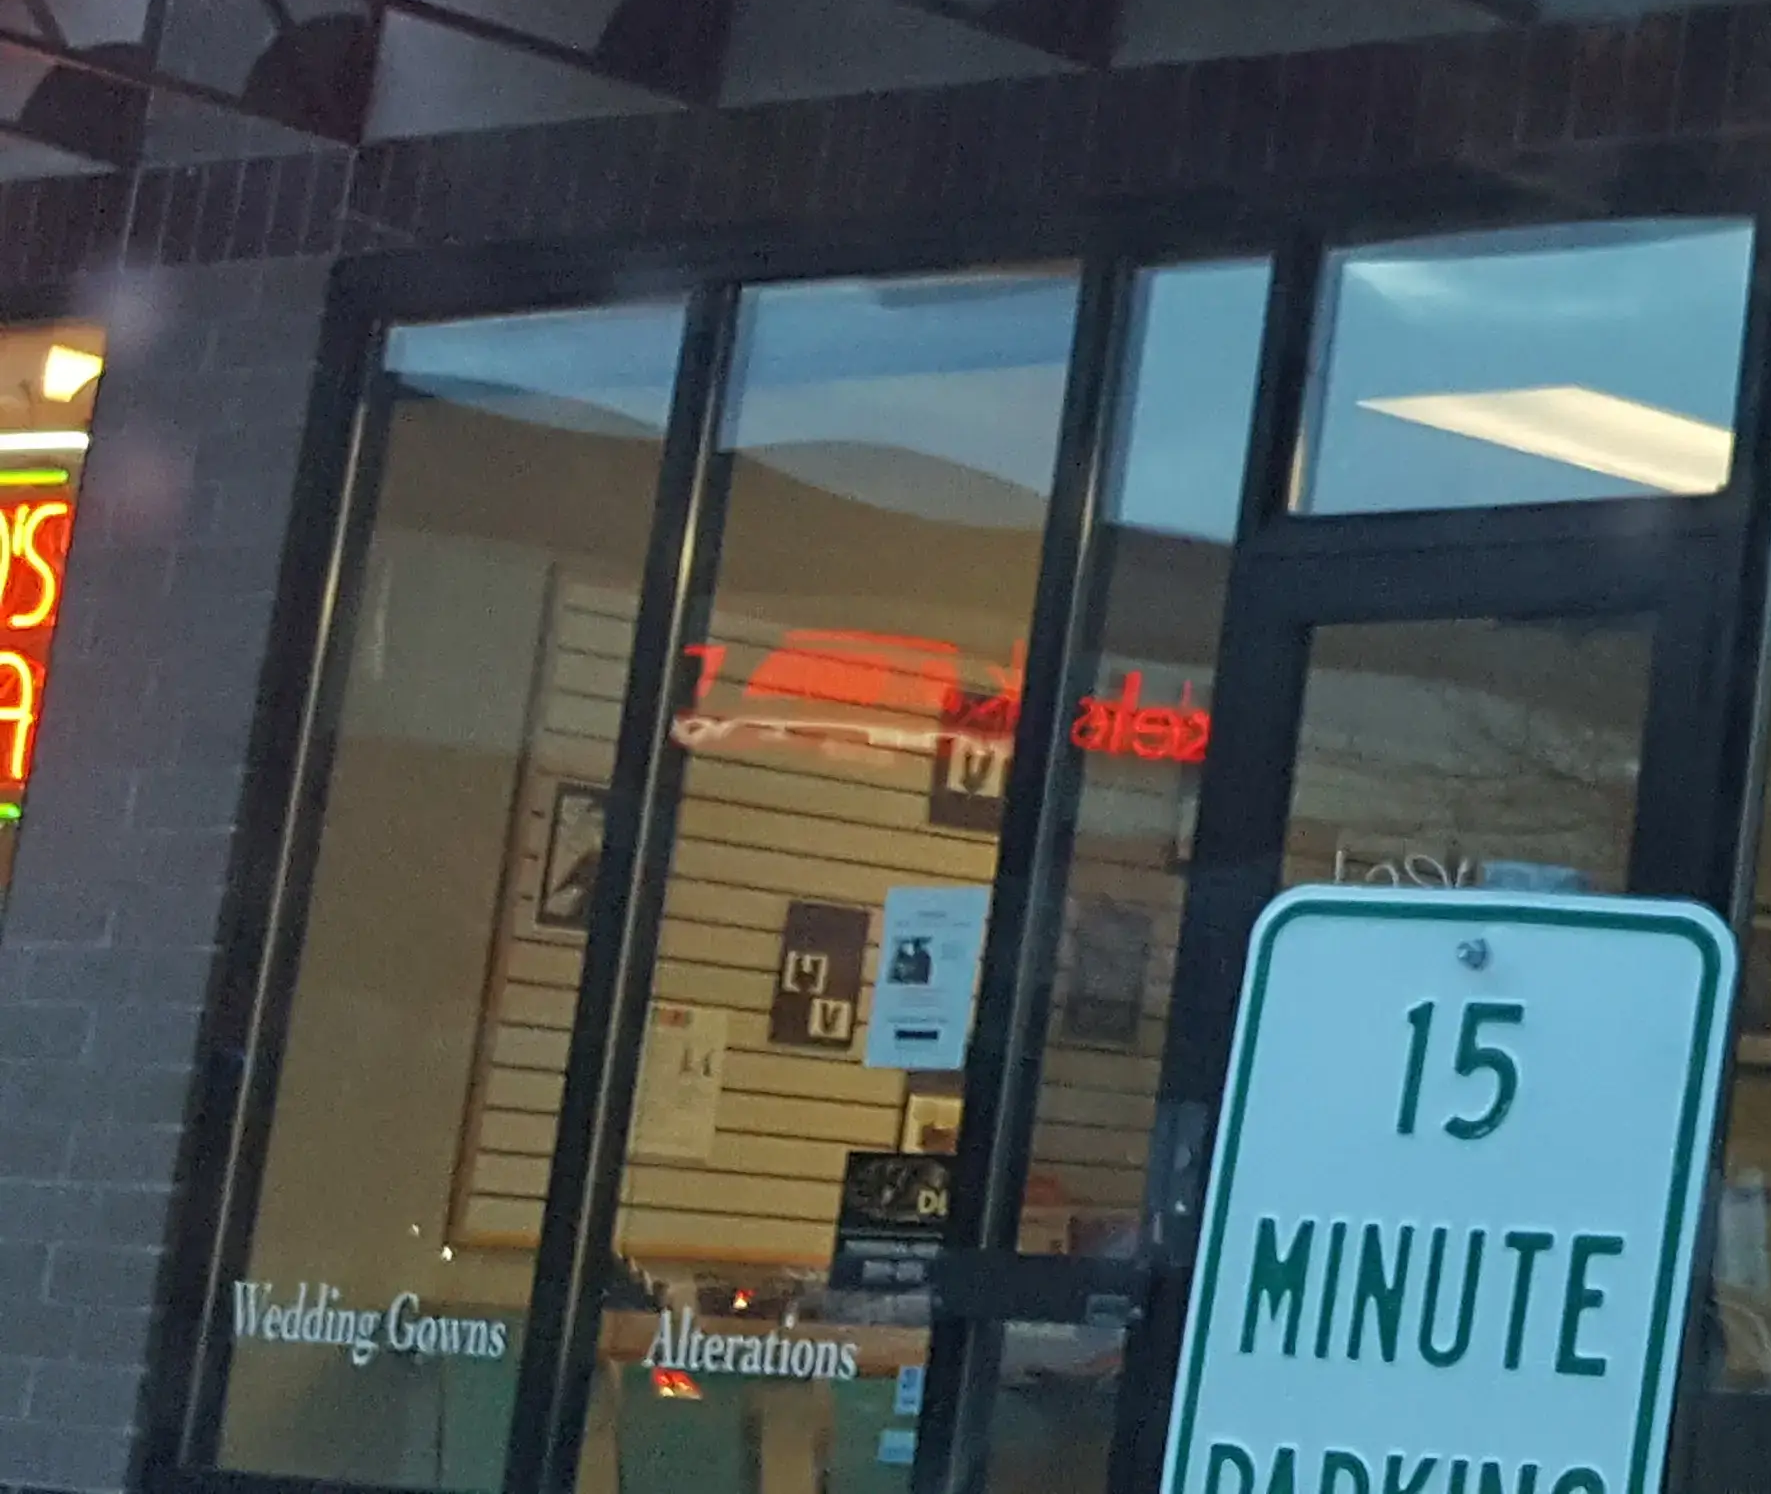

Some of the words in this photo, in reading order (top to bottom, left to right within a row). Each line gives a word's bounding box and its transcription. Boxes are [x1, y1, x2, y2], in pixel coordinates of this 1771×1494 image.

[1396, 1001, 1525, 1141] 15
[232, 1279, 381, 1366] Wedding
[387, 1292, 507, 1360] Gowns
[642, 1307, 860, 1380] Alterations
[1239, 1216, 1625, 1378] MINUTE
